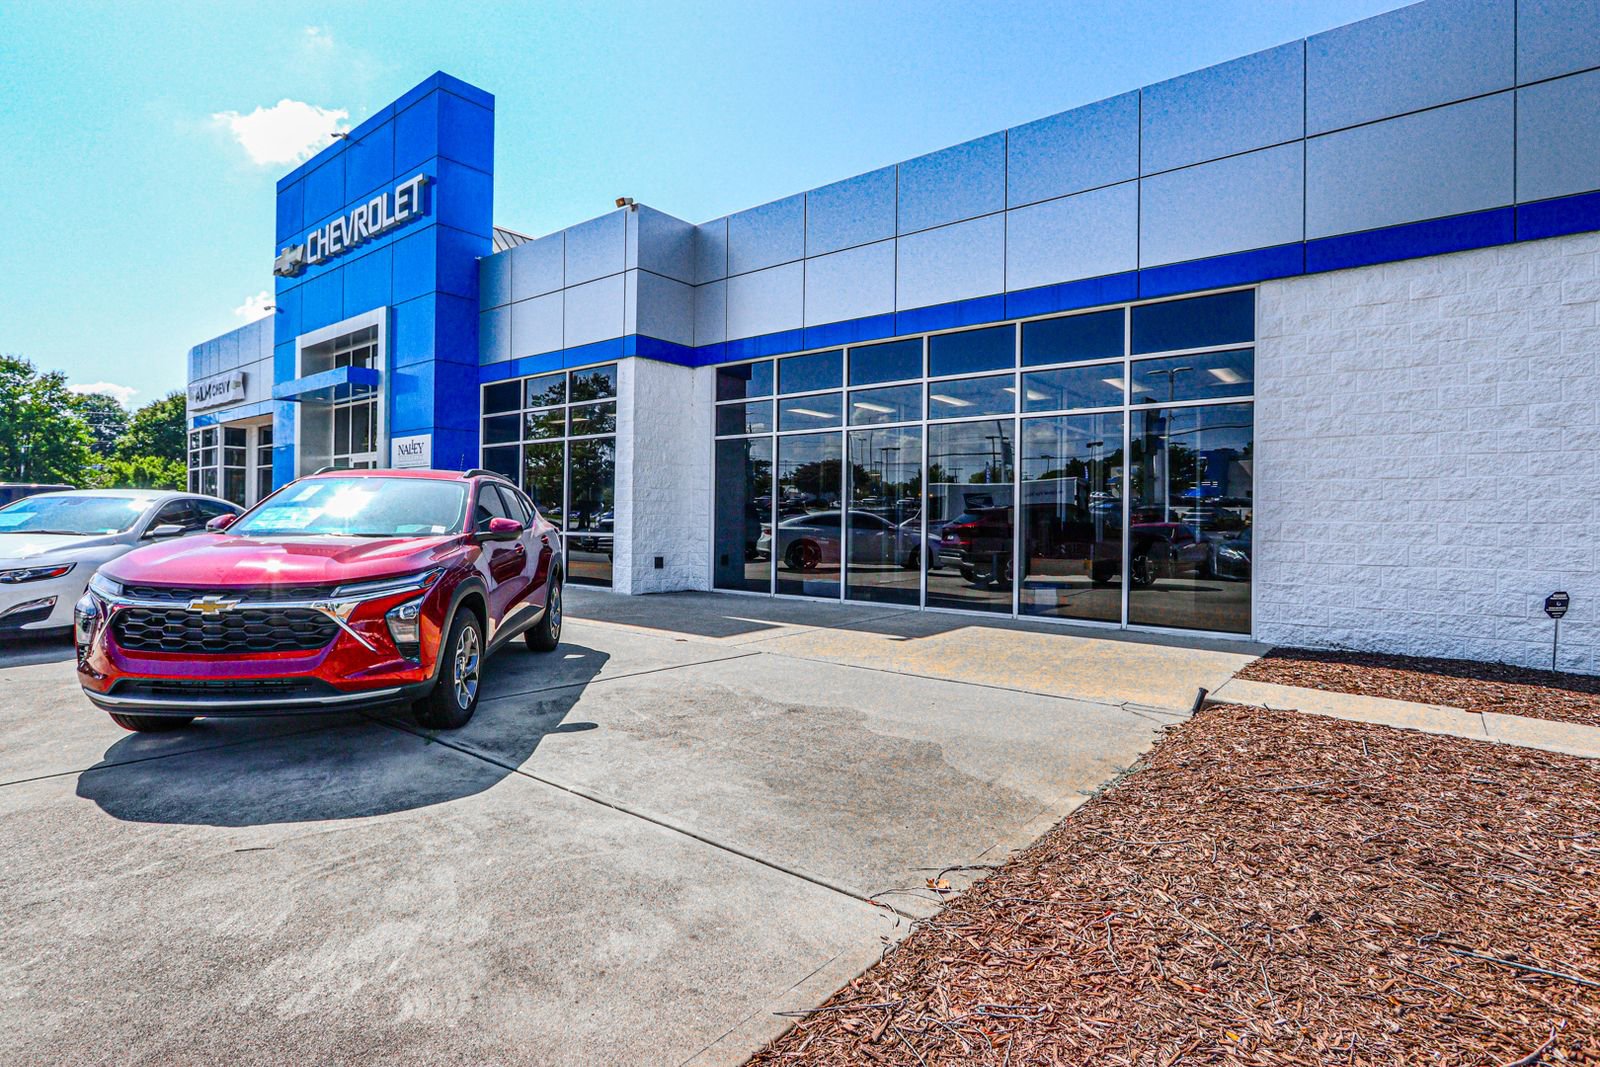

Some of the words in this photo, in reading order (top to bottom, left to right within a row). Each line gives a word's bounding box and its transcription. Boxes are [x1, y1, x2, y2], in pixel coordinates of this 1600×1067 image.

[307, 173, 425, 264] CHEVROLET
[212, 380, 231, 397] CHEVY
[398, 440, 425, 456] NALLEY
